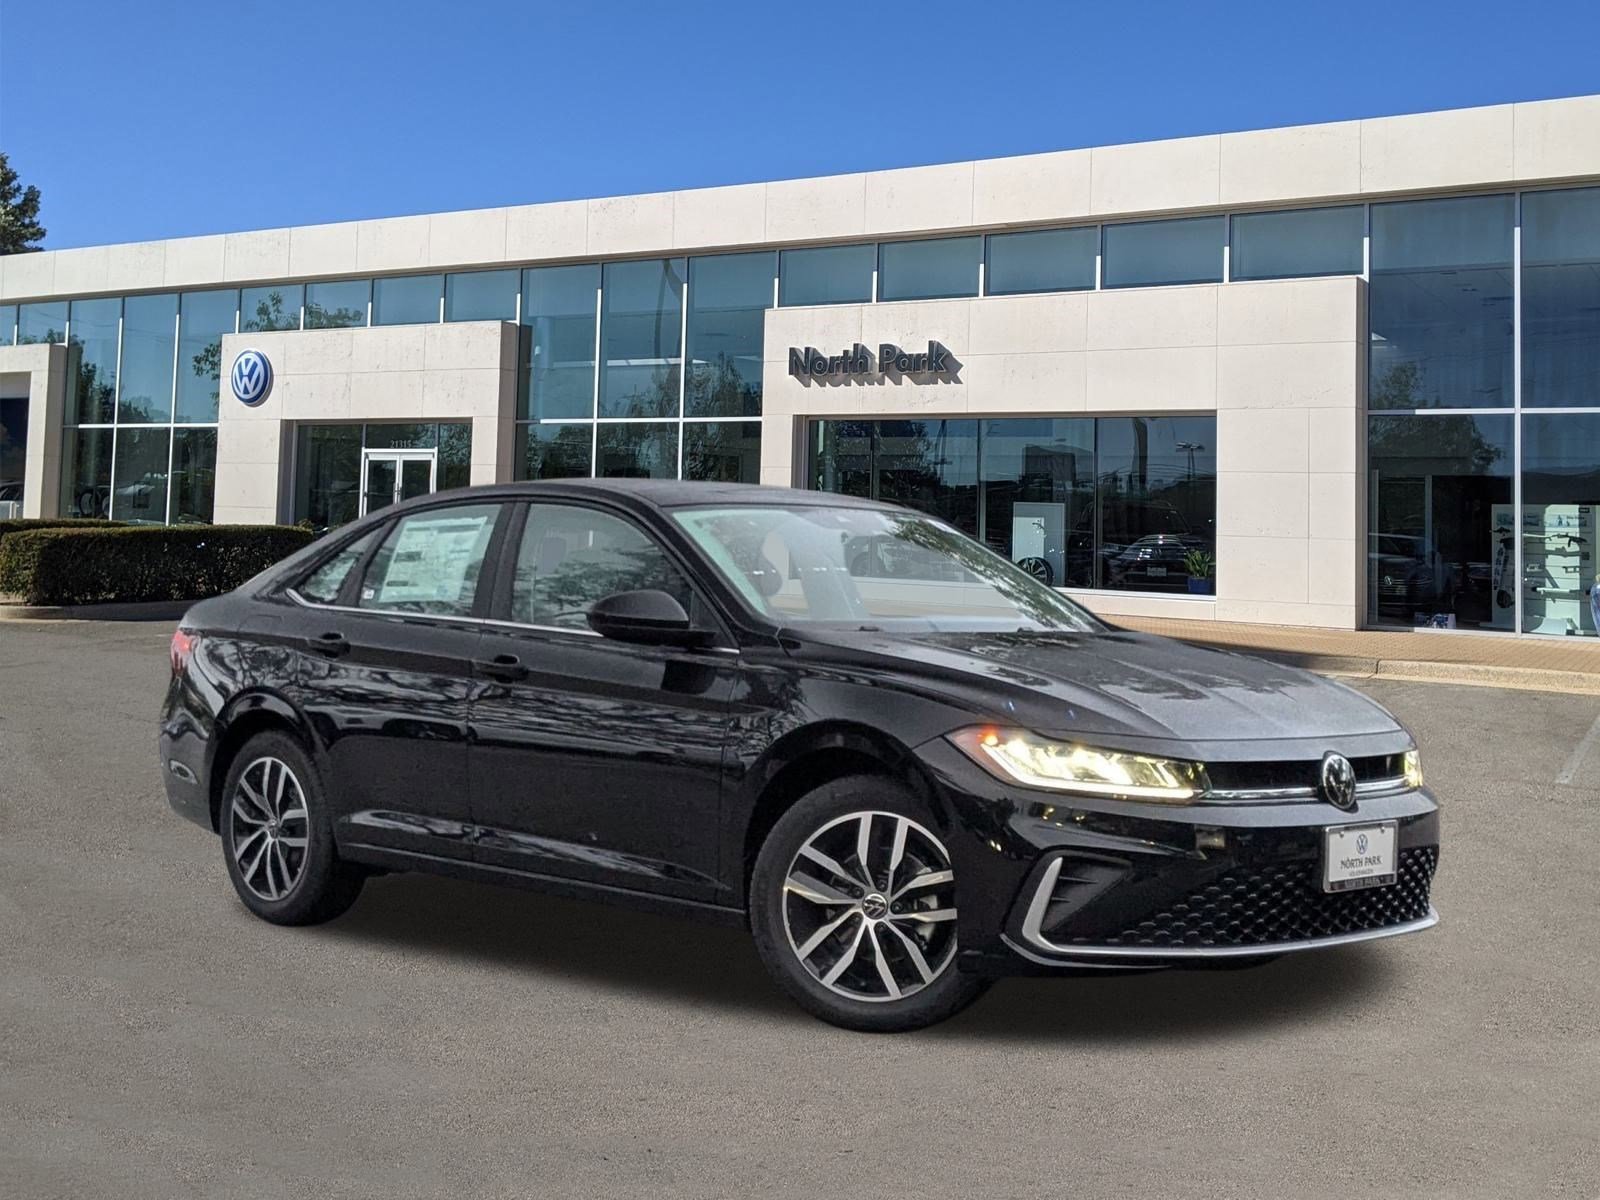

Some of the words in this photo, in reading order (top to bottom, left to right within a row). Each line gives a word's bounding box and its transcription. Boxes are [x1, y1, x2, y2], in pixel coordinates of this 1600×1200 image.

[789, 343, 869, 375] North
[879, 340, 946, 373] Park
[232, 351, 268, 403] VW
[1340, 857, 1363, 870] NORTH
[1364, 855, 1383, 867] PARK
